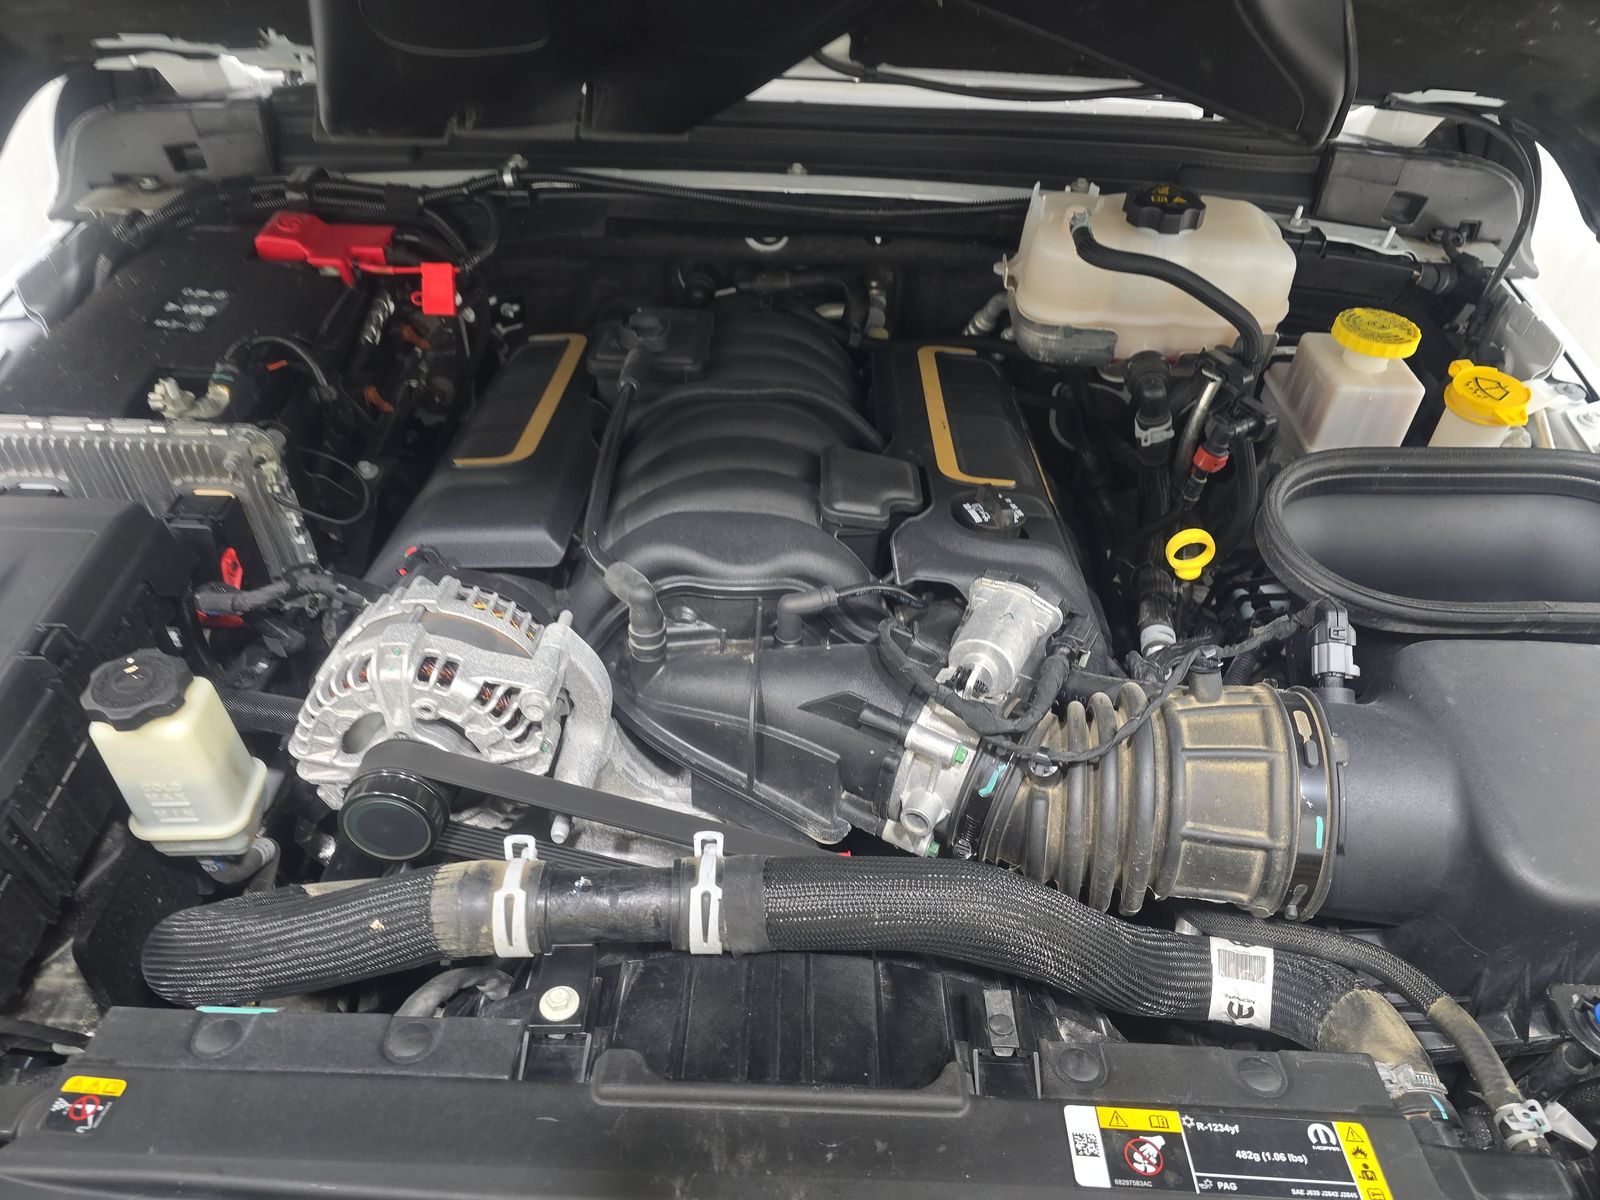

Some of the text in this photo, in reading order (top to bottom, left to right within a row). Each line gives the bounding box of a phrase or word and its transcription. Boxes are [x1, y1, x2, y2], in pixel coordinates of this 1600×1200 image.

[142, 782, 181, 792] COLD
[1196, 1122, 1240, 1135] R-1234yf
[1235, 1150, 1309, 1165] 482g (1.06 lbs)
[1217, 1181, 1238, 1191] PAG
